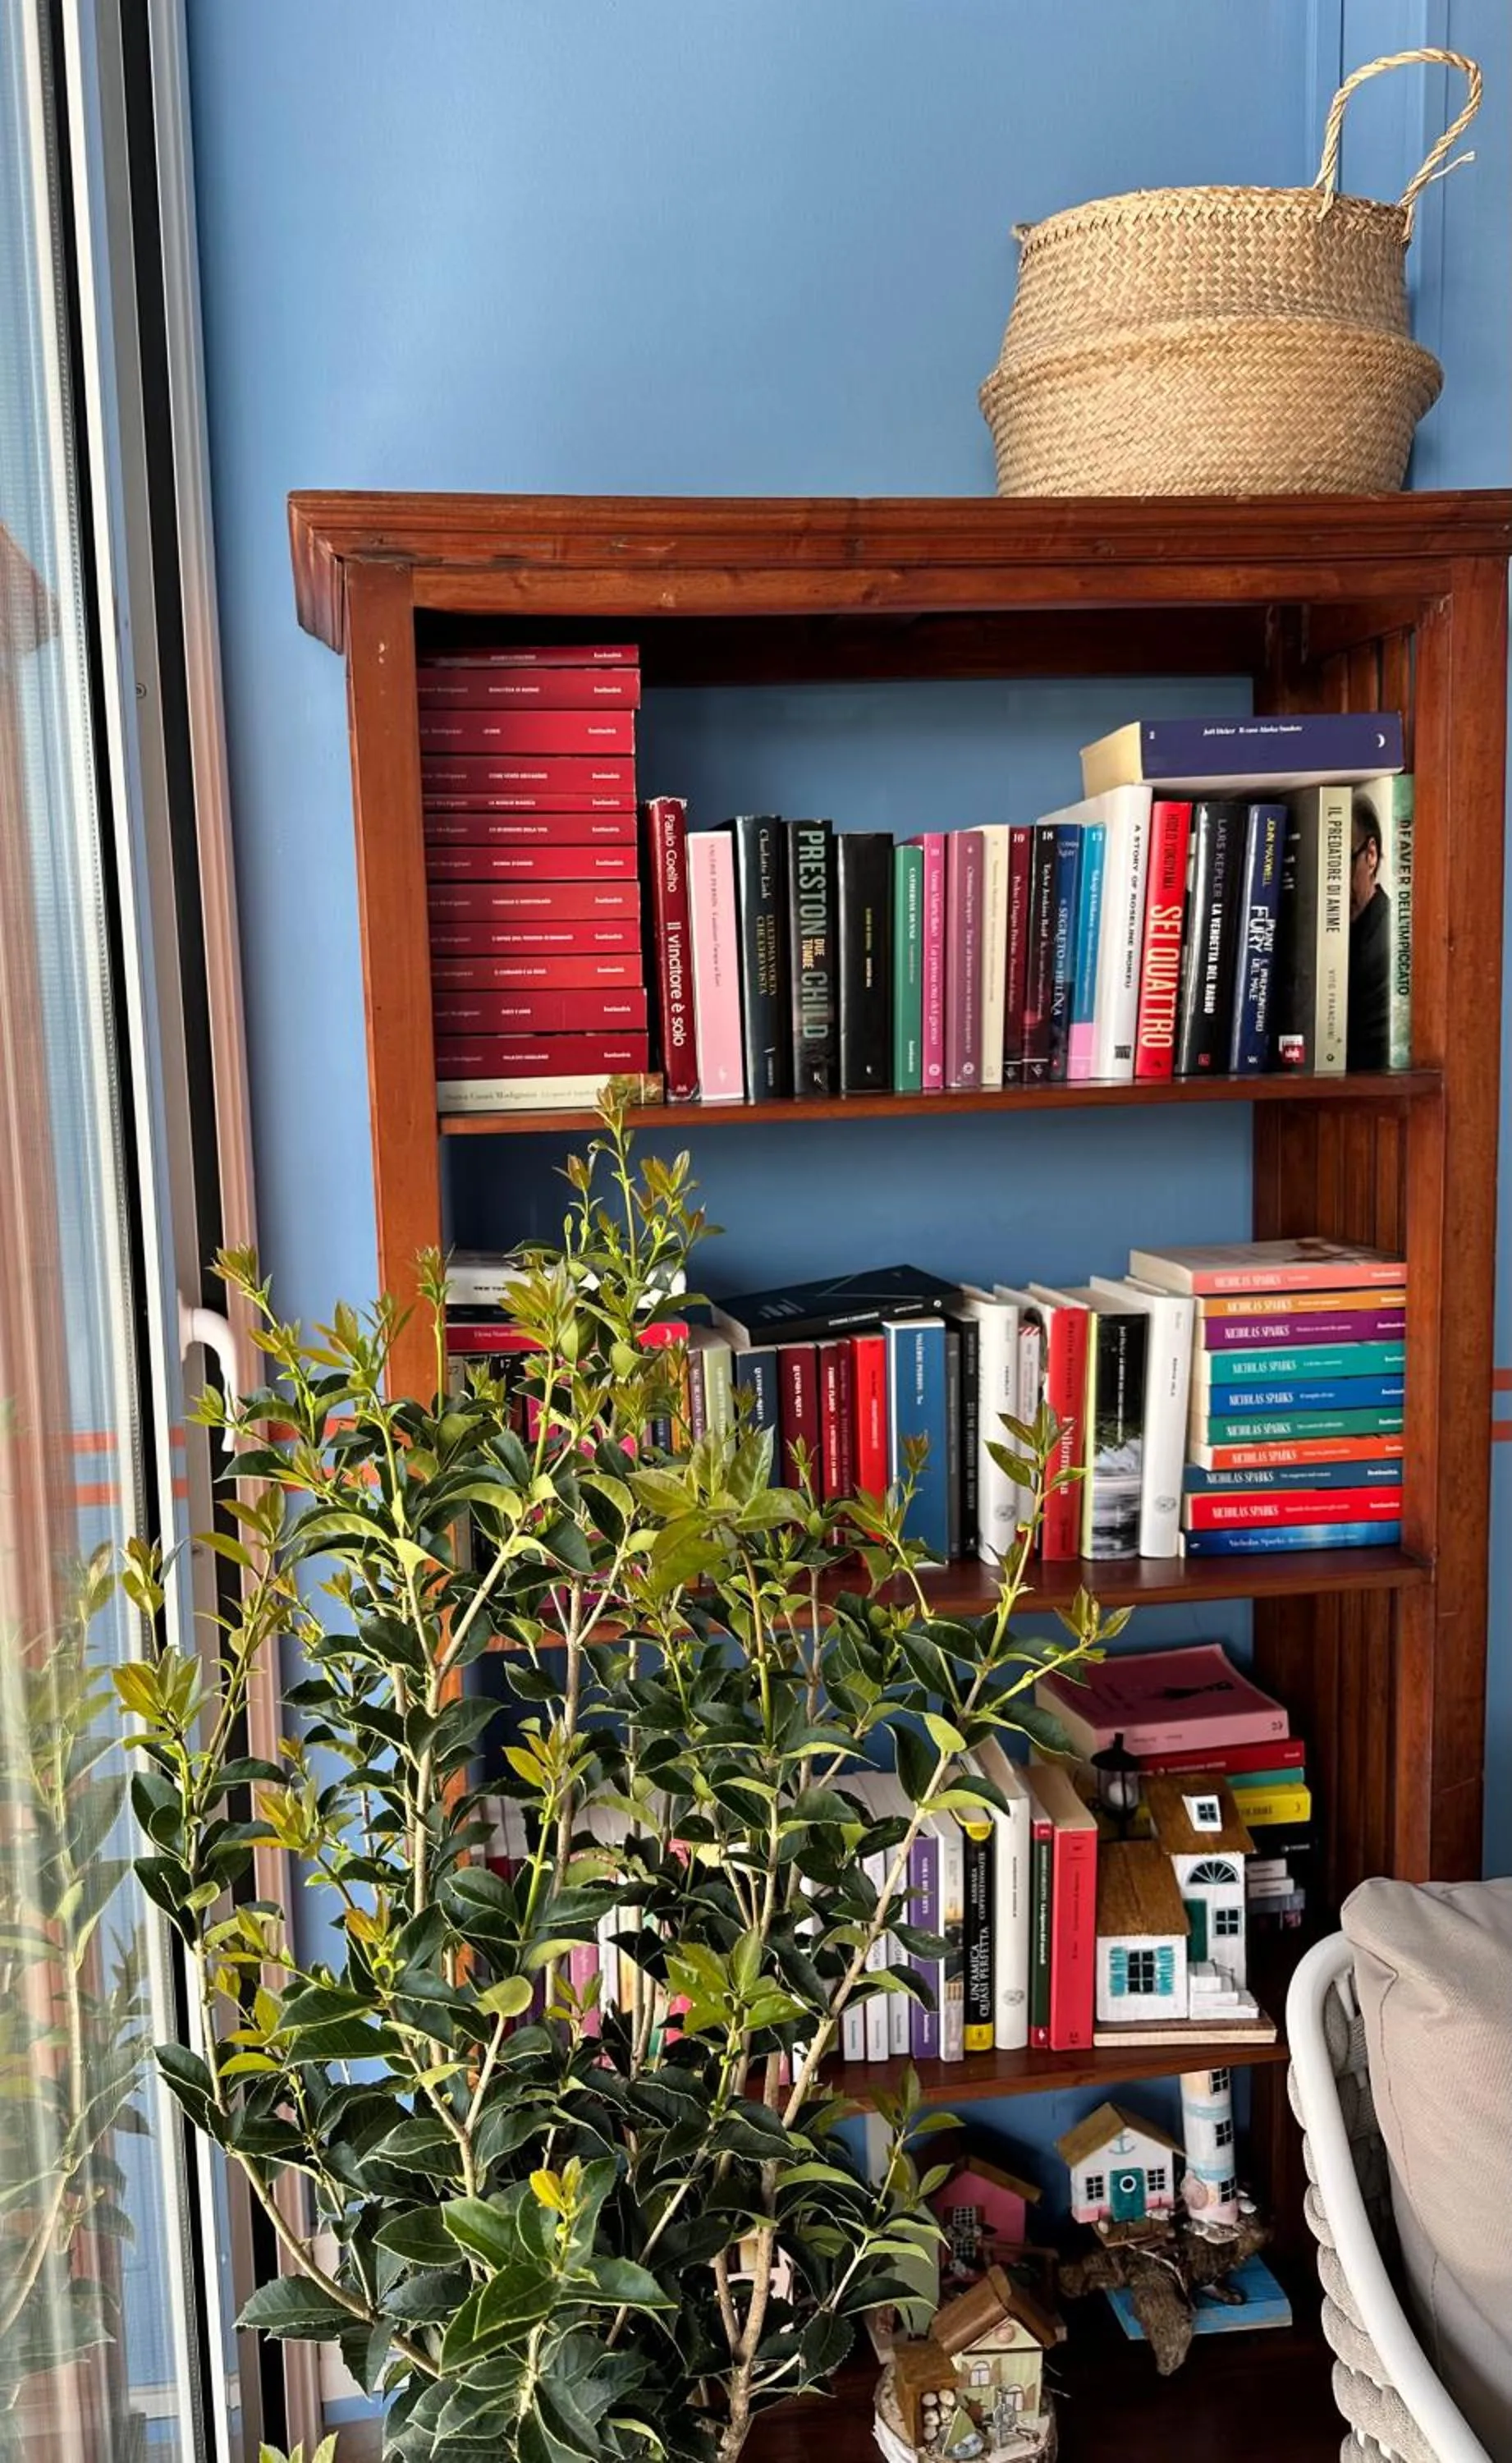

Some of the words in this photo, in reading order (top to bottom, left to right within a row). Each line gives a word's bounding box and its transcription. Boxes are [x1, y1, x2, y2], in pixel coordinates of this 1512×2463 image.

[1328, 806, 1342, 815] IL
[664, 814, 676, 846] Paulo
[1164, 814, 1180, 840] HIDEO
[1216, 819, 1227, 849] LARS
[1266, 817, 1276, 842] JOHN
[758, 828, 770, 874] Charlotte
[1132, 836, 1141, 871] STORY
[1161, 842, 1179, 889] YOKOYAMA
[1262, 843, 1275, 887] MAXWELL
[1326, 821, 1342, 881] PREDATORE
[665, 850, 678, 893] Coelho
[798, 830, 827, 936] PRESTON
[1130, 875, 1139, 889] OF
[1212, 853, 1226, 897] KEPLER
[760, 876, 771, 899] Link
[1326, 885, 1340, 897] DI
[1126, 893, 1138, 947] ROSELINE
[1148, 906, 1182, 939] SEI
[1211, 903, 1223, 915] LA
[1326, 898, 1340, 933] ANIME
[666, 921, 680, 930] Il
[1040, 919, 1049, 938] Reid
[1054, 907, 1068, 959] SEGRETO
[1208, 917, 1222, 962] VENDETTA
[1248, 906, 1269, 952] FURY
[802, 939, 813, 970] TOMBE
[813, 938, 825, 956] DUE
[1397, 891, 1410, 996] DELL'IMPICCATO
[667, 934, 683, 998] vincitore
[1207, 965, 1219, 981] DEL
[1250, 958, 1261, 975] DEL
[1328, 969, 1336, 989] VITO
[1052, 970, 1065, 1016] HELENA
[1141, 947, 1180, 1048] QUATTRO
[1203, 984, 1217, 1014] RAGNO
[1249, 978, 1259, 1001] MALE
[671, 1003, 685, 1013] è
[801, 971, 828, 1039] CHILD
[1327, 993, 1336, 1039] FRANCHINI
[671, 1017, 686, 1047] solo
[1215, 1276, 1251, 1288] NICHOLAS
[1253, 1274, 1281, 1287] SPARKS
[1226, 1300, 1262, 1313] NICHOLAS
[1264, 1299, 1292, 1310] SPARKS
[1225, 1326, 1260, 1339] NICHOLAS
[1262, 1324, 1290, 1337] SPARKS
[1233, 1361, 1267, 1374] NICHOLAS
[1269, 1360, 1296, 1371] SPARKS
[1229, 1393, 1265, 1406] NICHOLAS
[1266, 1392, 1294, 1404] SPARKS
[1226, 1424, 1262, 1437] NICHOLAS
[1263, 1422, 1291, 1434] SPARKS
[1232, 1452, 1268, 1464] NICHOLAS
[1269, 1449, 1297, 1461] SPARKS
[1206, 1472, 1242, 1484] NICHOLAS
[1244, 1470, 1274, 1483] SPARKS
[1212, 1507, 1249, 1519] NICHOLAS
[1250, 1505, 1279, 1517] SPARKS
[978, 1926, 990, 1979] PERFETTA
[969, 1943, 980, 2001] UN'AMICA
[979, 1981, 990, 2017] QUASI
